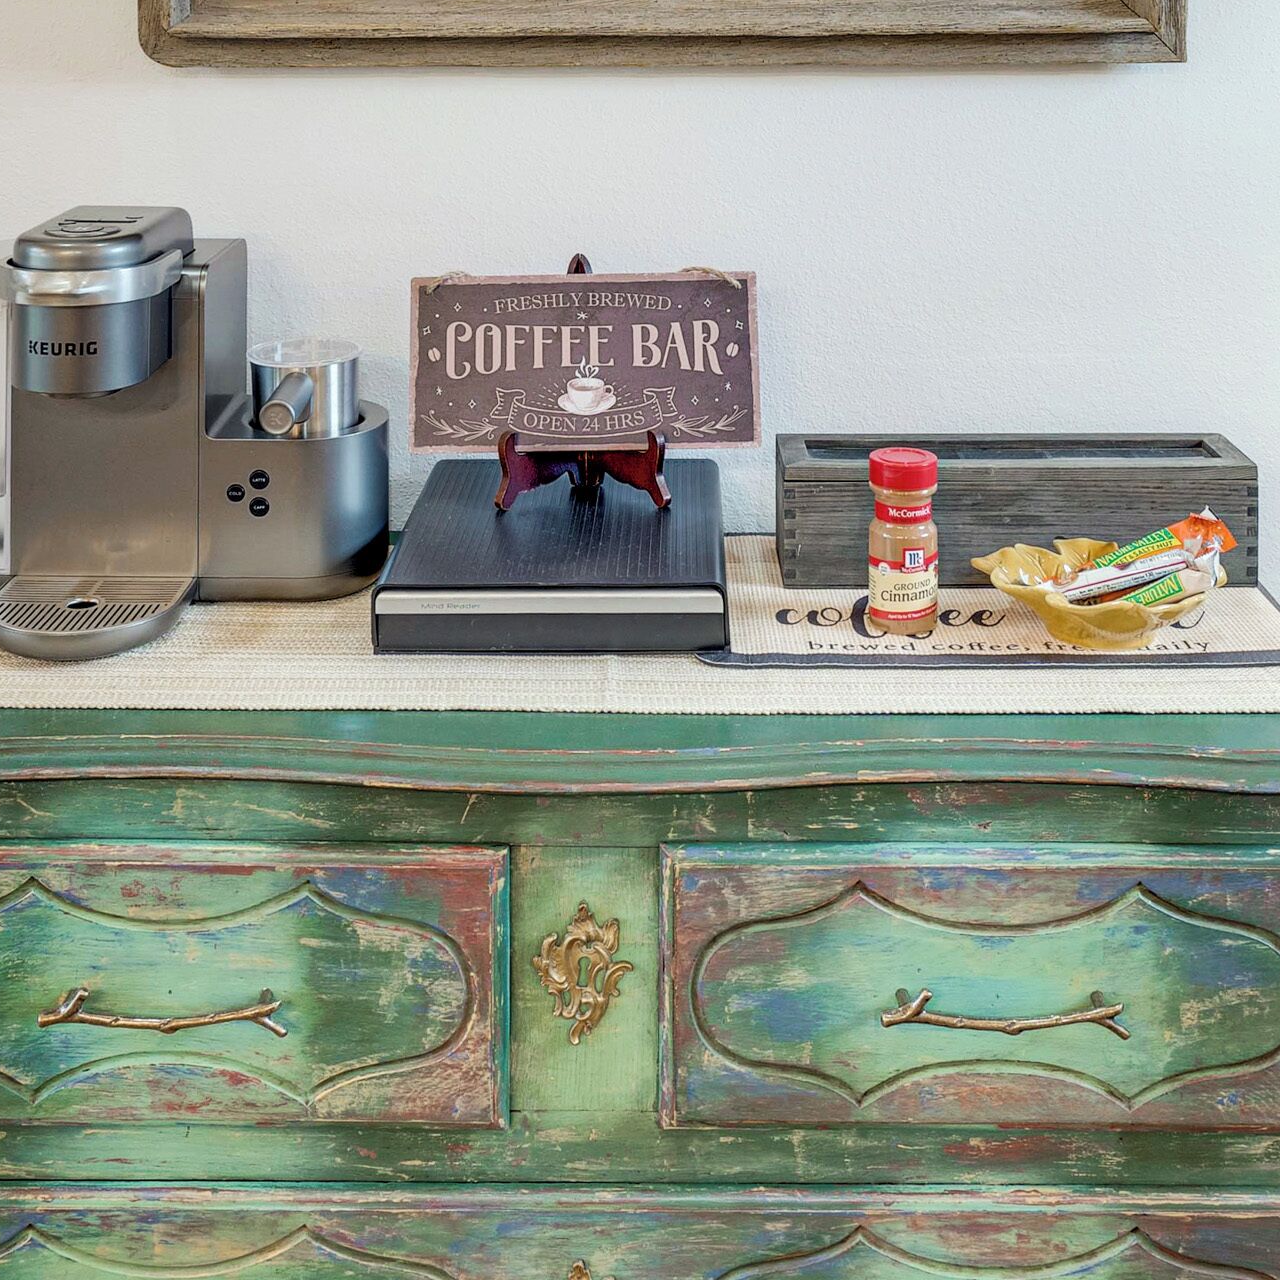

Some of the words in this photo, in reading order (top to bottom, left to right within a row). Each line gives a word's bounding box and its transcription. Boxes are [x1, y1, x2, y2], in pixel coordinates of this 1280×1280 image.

[494, 291, 583, 314] FRESHLY
[586, 291, 672, 312] BREWED
[28, 339, 99, 357] KEURIG
[445, 320, 616, 380] COFFEE
[631, 318, 724, 376] BAR
[522, 412, 577, 433] OPEN
[581, 416, 601, 433] 24
[605, 410, 646, 431] HRS
[887, 505, 932, 518] McCormick
[1132, 528, 1169, 548] VALLEY
[893, 578, 931, 592] GROUND
[775, 595, 1006, 640] cofee
[808, 640, 917, 651] brewed
[932, 640, 1031, 651] coffee,
